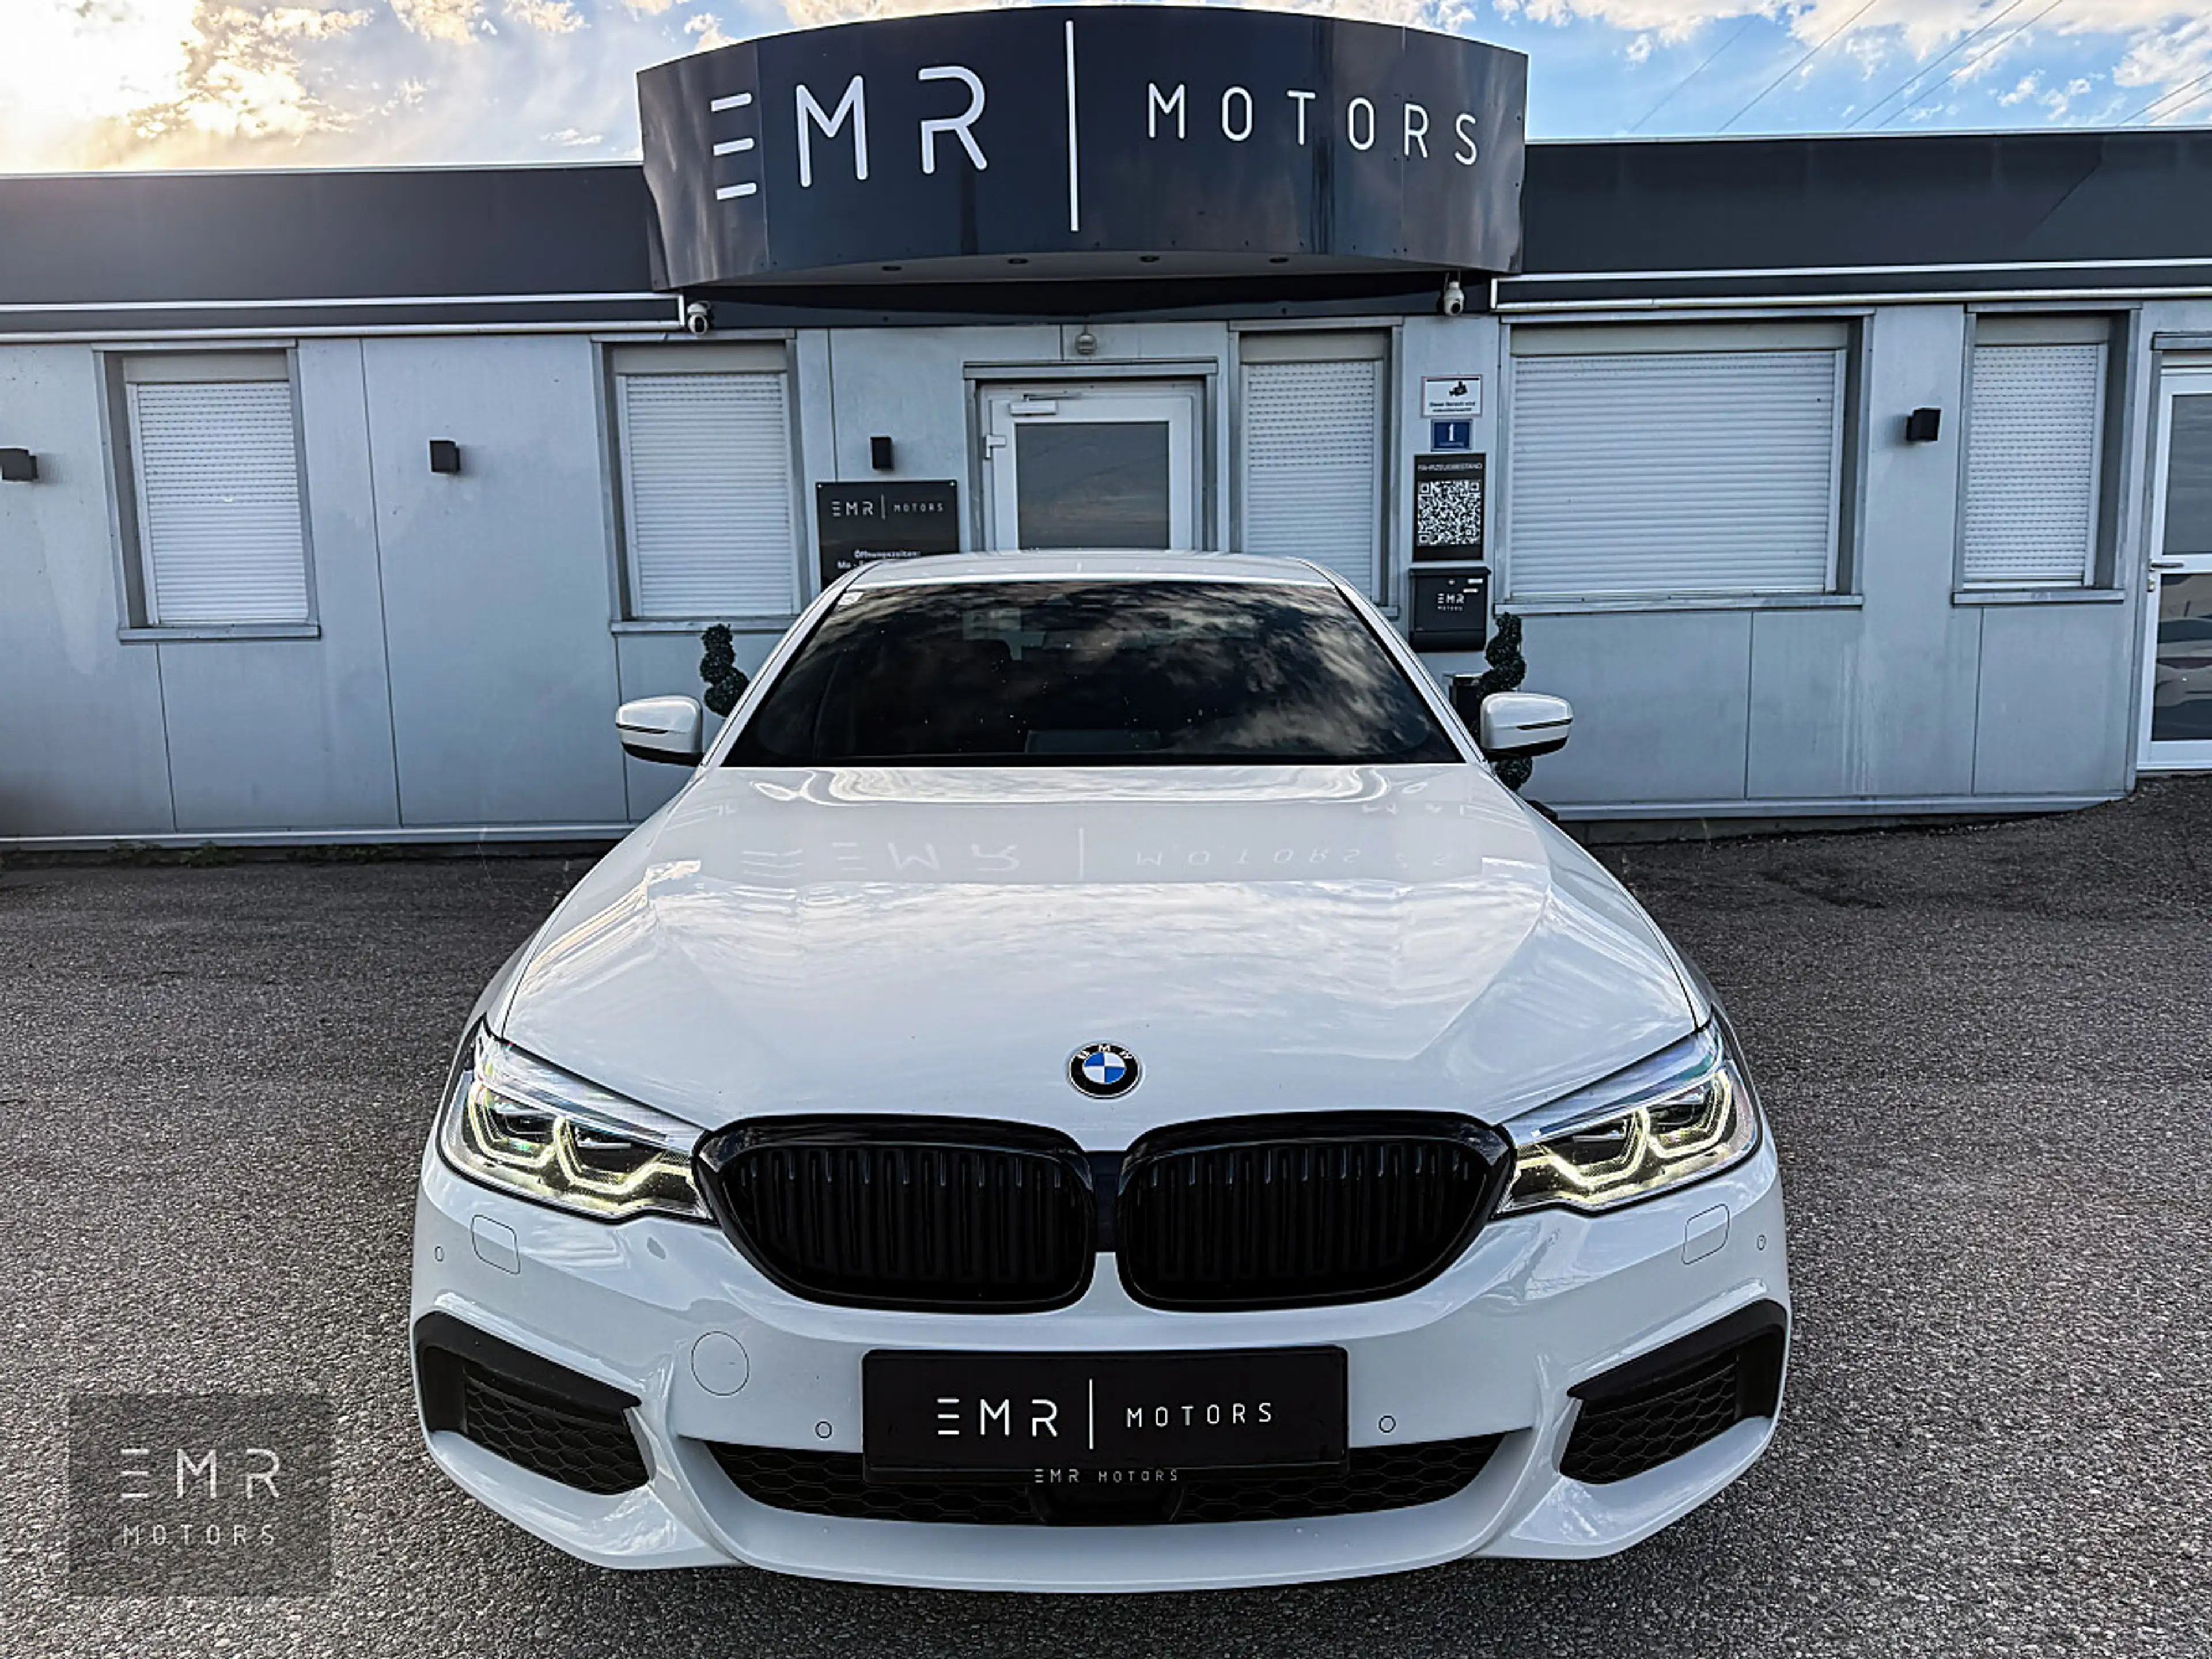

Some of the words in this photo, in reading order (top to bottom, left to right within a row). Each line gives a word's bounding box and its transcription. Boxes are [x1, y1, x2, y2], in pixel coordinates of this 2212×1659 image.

[710, 65, 989, 201] EMR
[1147, 82, 1479, 166] MOTORS
[832, 501, 874, 517] EMR
[893, 503, 944, 512] MOTORS
[1437, 593, 1464, 604] EMR
[937, 1398, 1058, 1437] EMR
[1127, 1402, 1272, 1428] MOTORS
[1034, 1468, 1080, 1483] EMR
[1098, 1469, 1178, 1483] MOTORS
